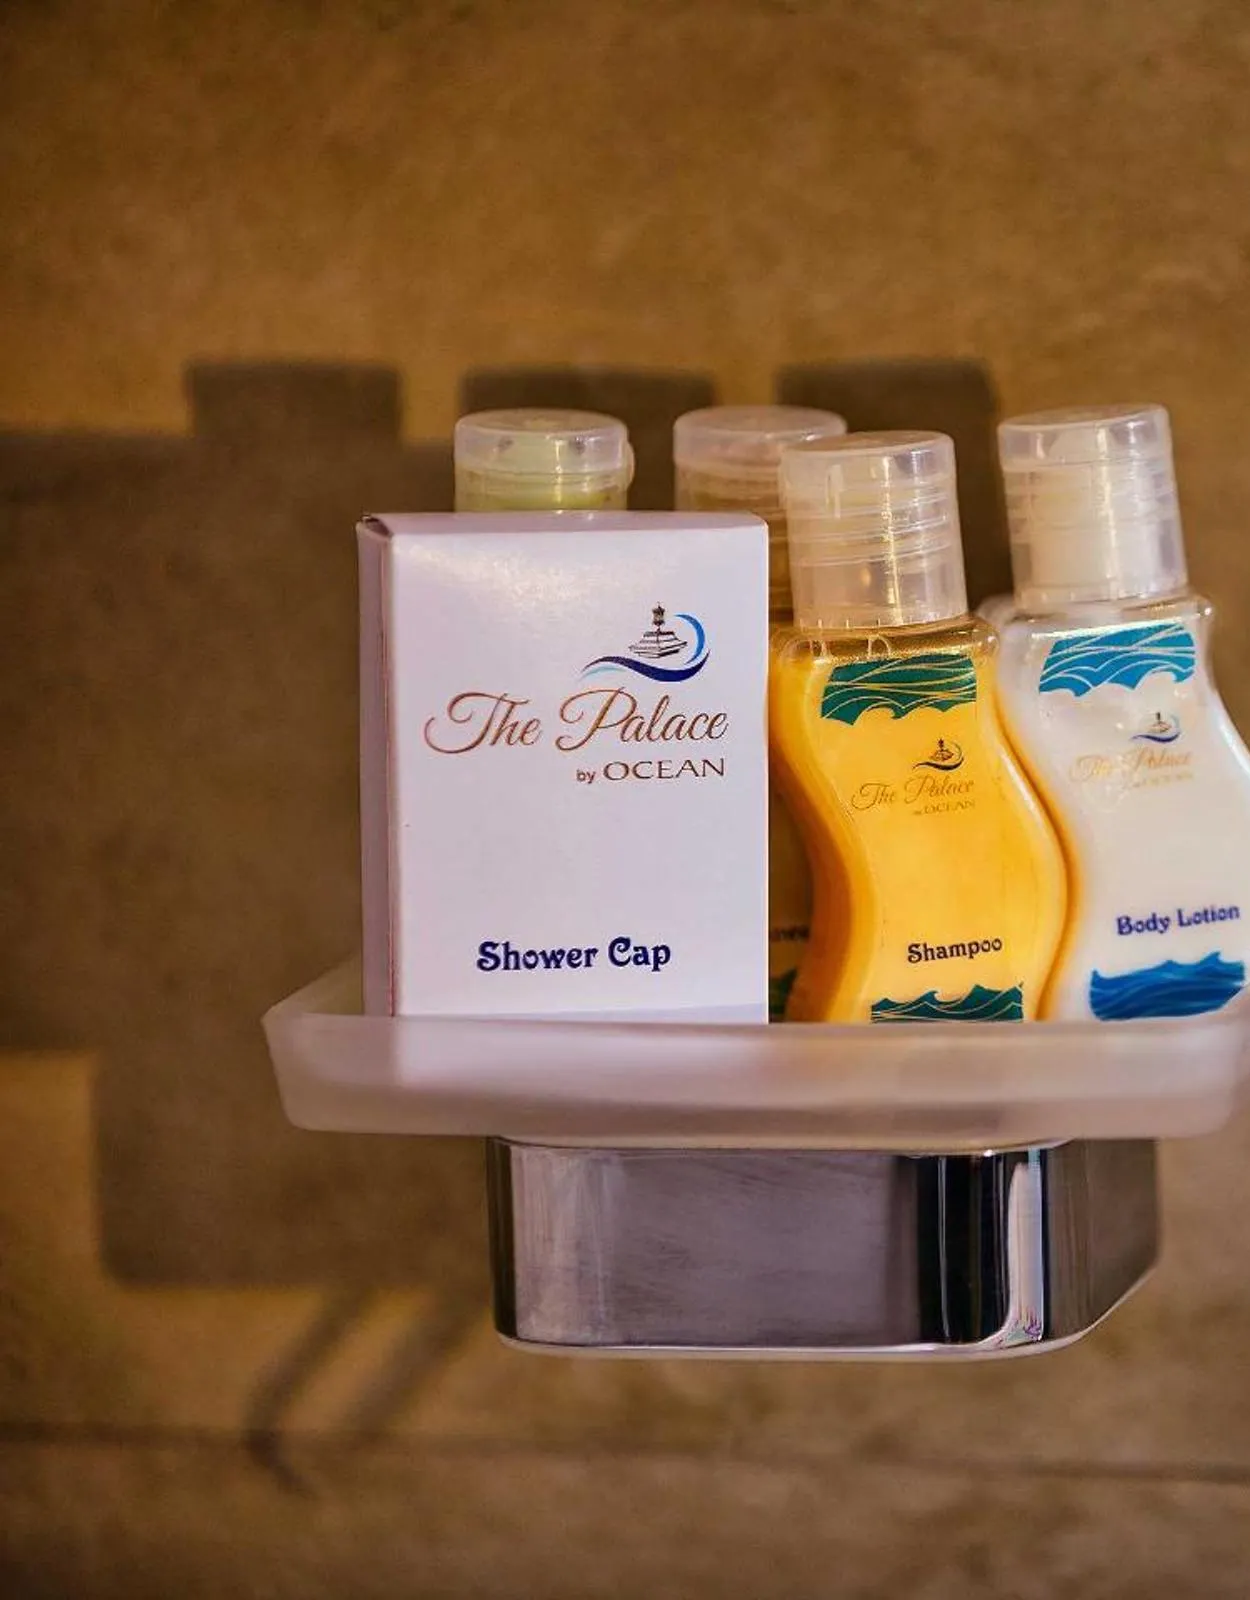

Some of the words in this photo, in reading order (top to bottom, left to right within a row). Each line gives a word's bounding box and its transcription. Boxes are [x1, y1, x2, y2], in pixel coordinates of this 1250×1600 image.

[424, 692, 541, 754] The
[555, 687, 728, 751] Palace
[576, 768, 597, 784] by
[603, 758, 725, 781] OCEAN
[1116, 911, 1171, 936] Body
[1177, 904, 1240, 927] Lotion
[477, 941, 598, 971] Shower
[608, 937, 671, 971] Cap
[907, 938, 1002, 963] Shampoo
